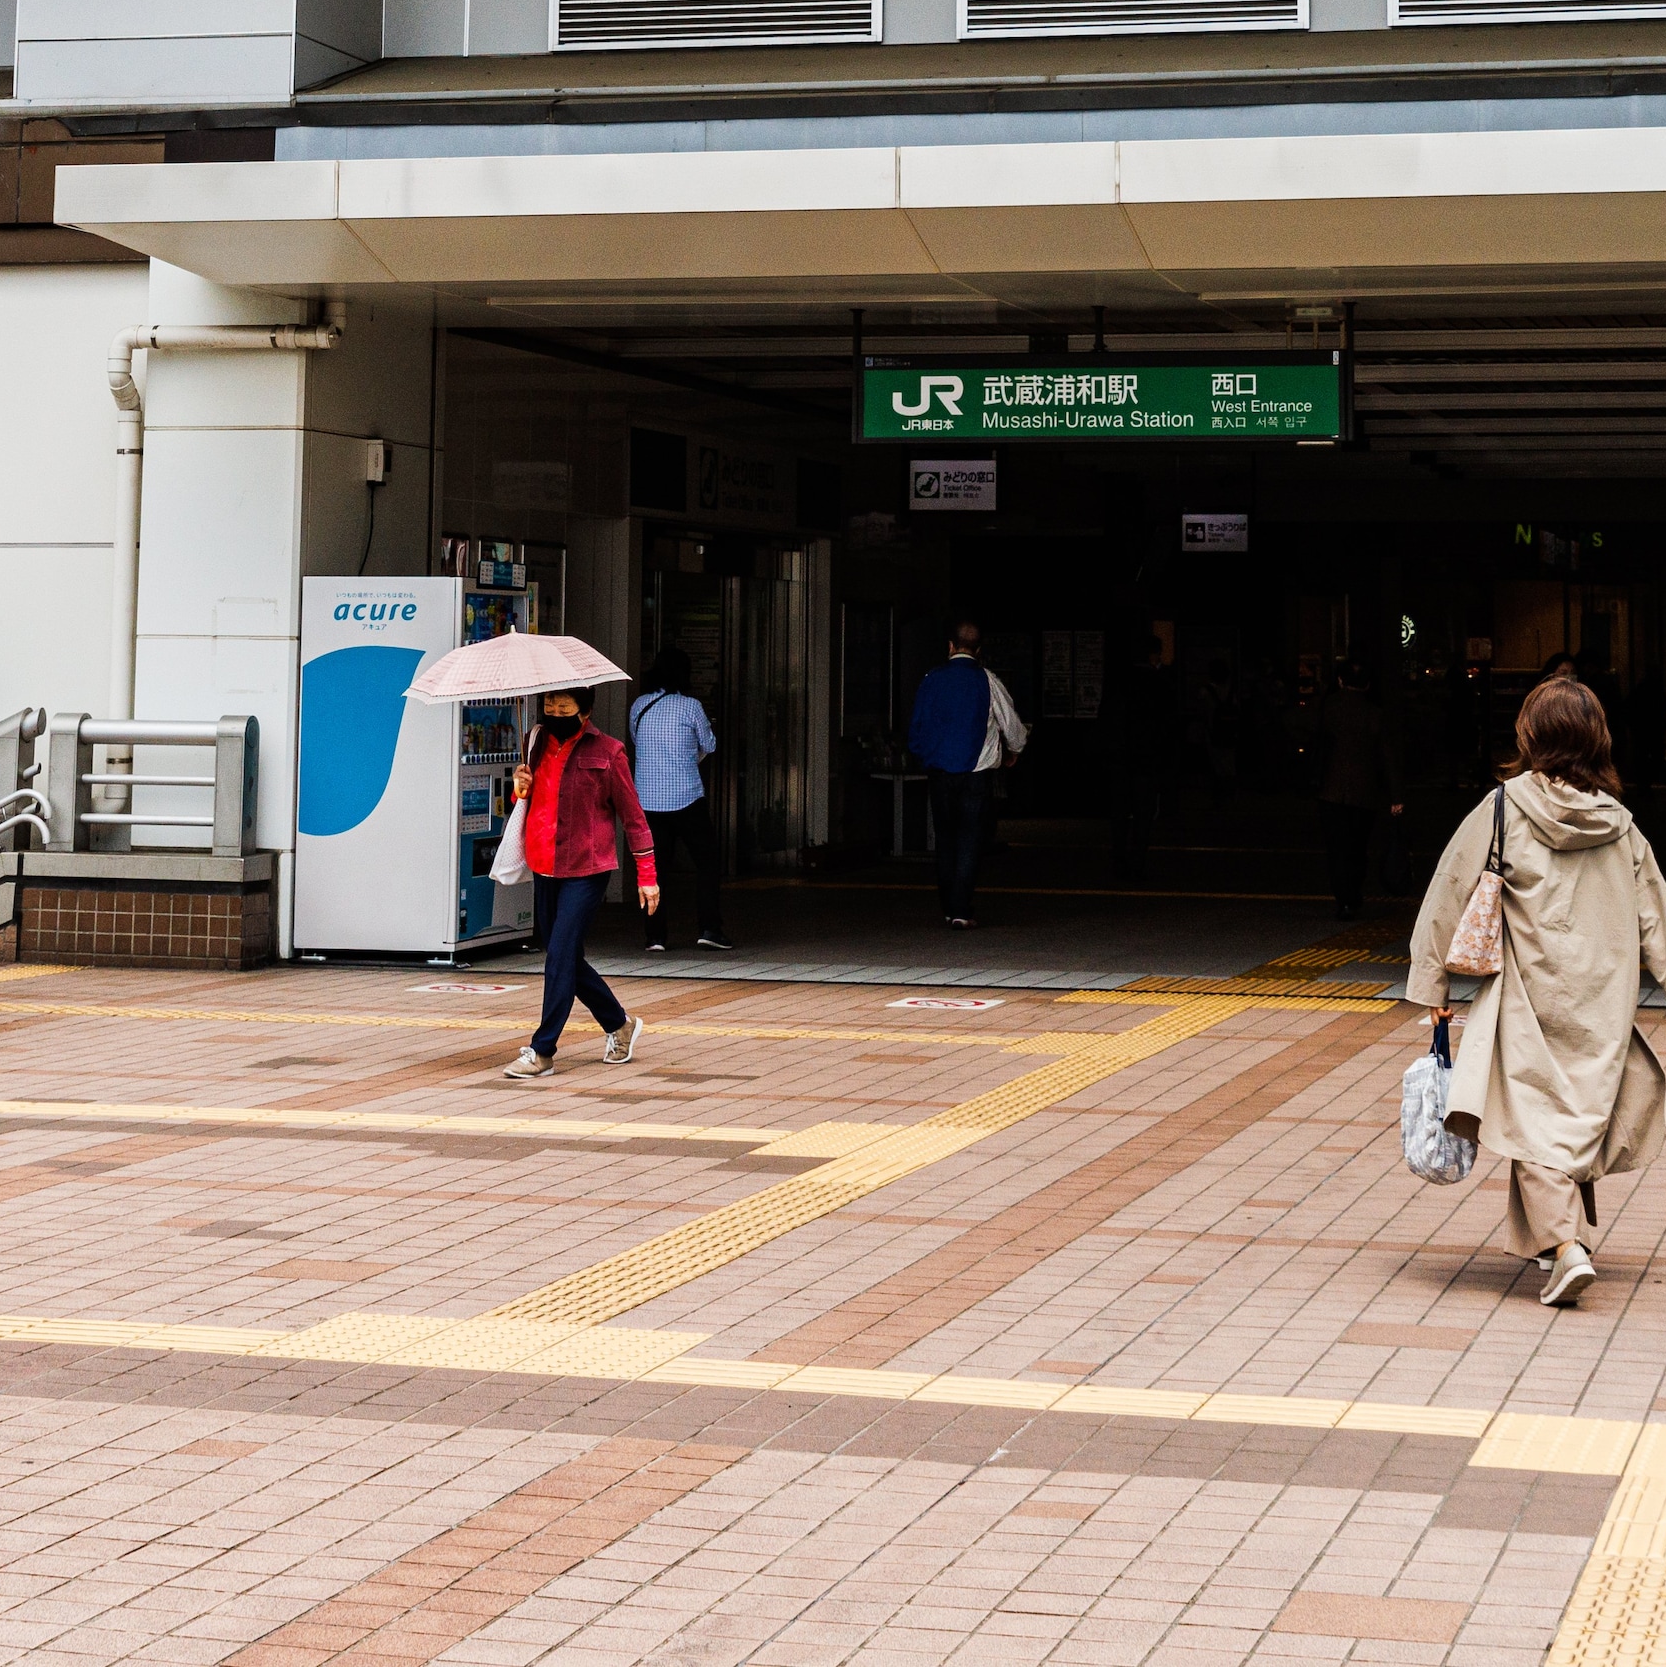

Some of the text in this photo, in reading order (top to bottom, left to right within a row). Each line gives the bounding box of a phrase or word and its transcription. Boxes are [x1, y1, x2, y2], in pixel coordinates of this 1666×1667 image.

[983, 374, 1139, 407] 武蔵浦和駅
[1211, 373, 1257, 396] 西口
[892, 375, 964, 416] JR
[1211, 399, 1313, 413] West Entrance
[902, 419, 955, 431] JR東日本
[982, 410, 1194, 430] Musashi-Urawa Station
[1211, 416, 1247, 429] 西入口
[943, 472, 995, 483] みどりの窓口
[333, 603, 417, 621] acure
